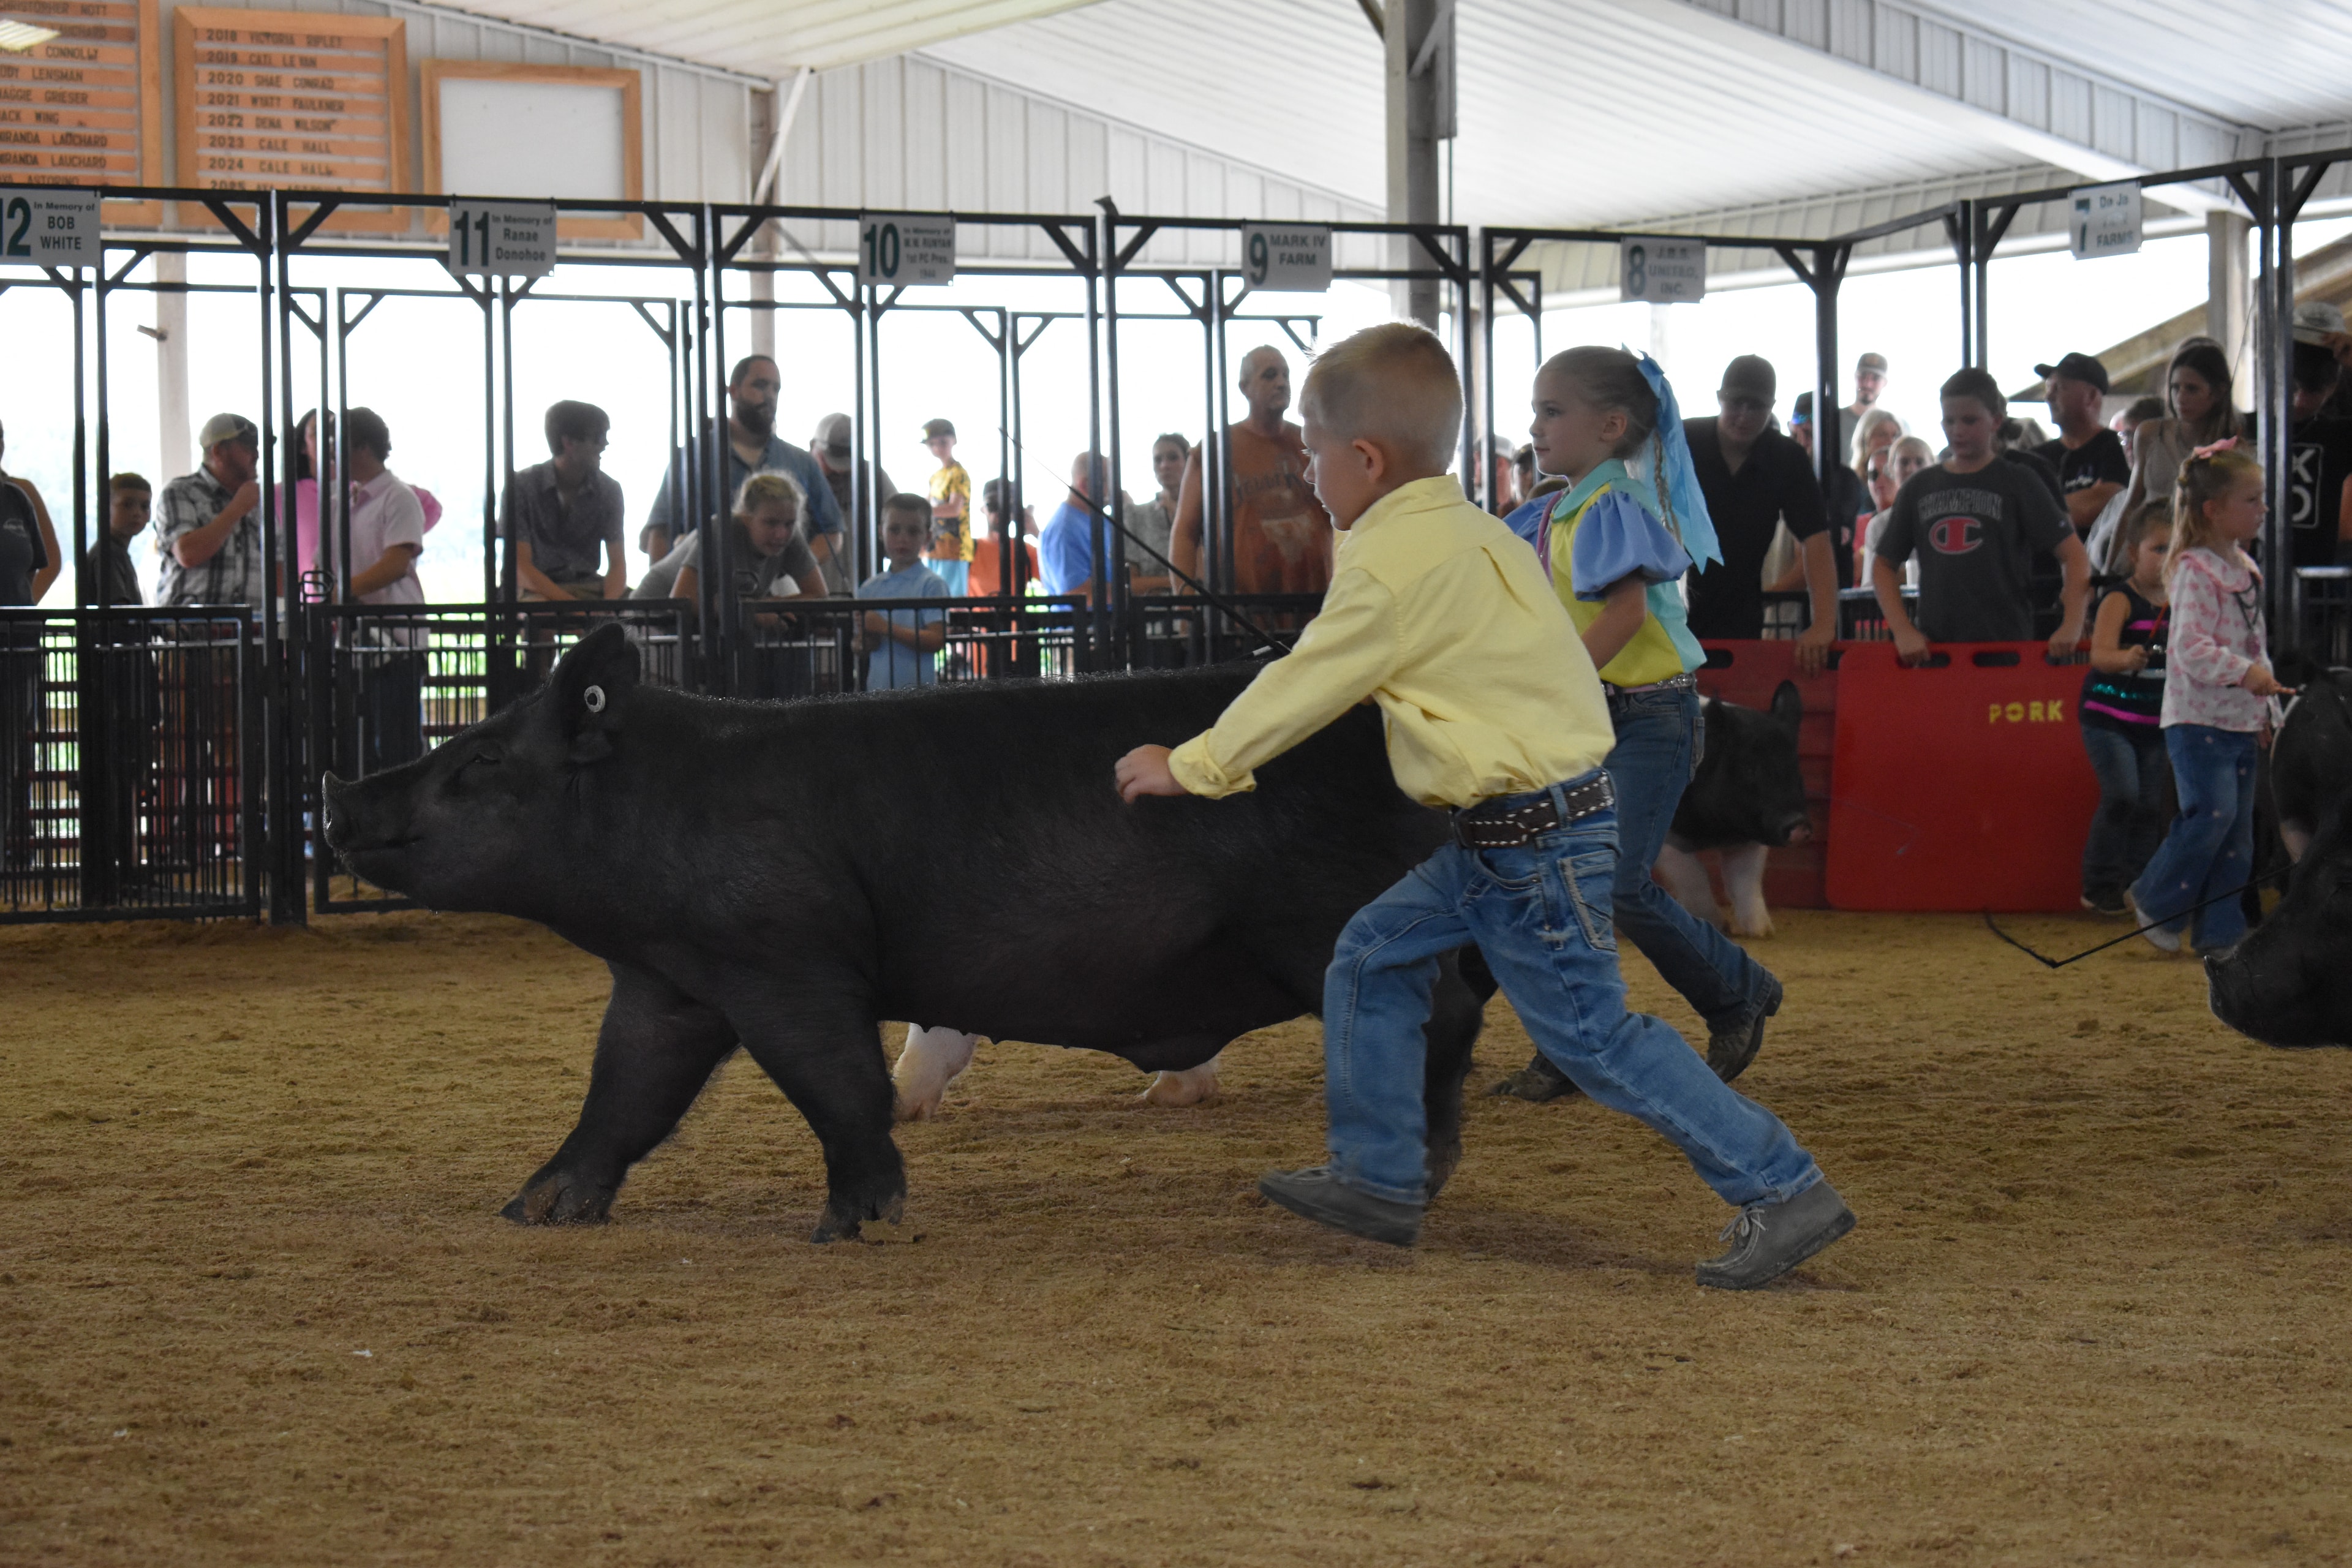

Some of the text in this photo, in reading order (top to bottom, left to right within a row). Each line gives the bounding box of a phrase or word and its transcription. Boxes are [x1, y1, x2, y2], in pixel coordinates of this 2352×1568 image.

[208, 51, 238, 63] 2019
[32, 67, 83, 81] LENSMAN
[209, 72, 244, 85] 2020
[208, 92, 239, 106] 2021
[209, 114, 244, 128] 2022
[209, 135, 331, 154] 2023 CALE HALL
[209, 157, 331, 176] 2024 CALE HALL
[45, 203, 83, 212] Memory
[0, 196, 32, 256] 2
[48, 216, 75, 229] BOB
[503, 216, 540, 225] Memory
[2075, 198, 2091, 252] 7
[454, 211, 489, 266] 11
[503, 228, 538, 241] Ranae
[1270, 235, 1325, 248] MARK IV
[40, 236, 82, 250] WHITE
[496, 247, 546, 261] Donohoe
[864, 223, 900, 278] 10
[1250, 233, 1268, 286] 9
[1280, 253, 1316, 266] FARM
[1627, 245, 1646, 296] 8
[1989, 699, 2064, 725] PORK
